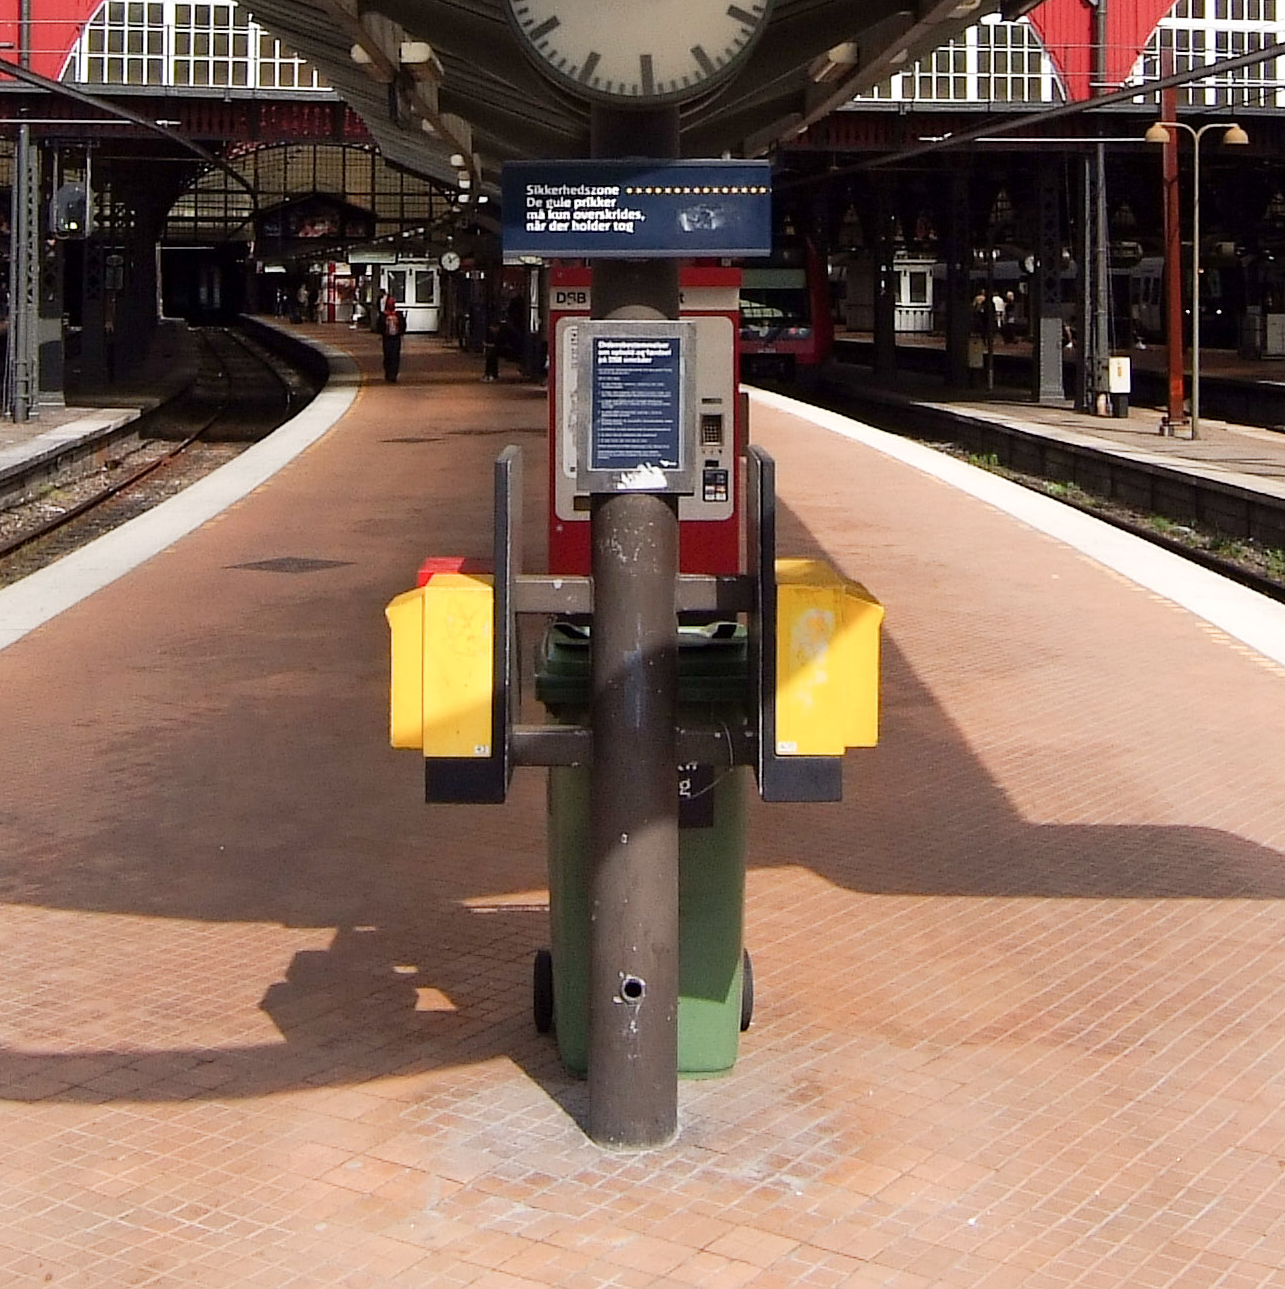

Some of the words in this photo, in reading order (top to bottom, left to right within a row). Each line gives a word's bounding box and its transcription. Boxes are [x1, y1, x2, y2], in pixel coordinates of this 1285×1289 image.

[526, 185, 620, 195] Sikkerhedszone
[526, 197, 543, 208] De
[546, 197, 571, 210] gule
[574, 196, 617, 210] prikker
[526, 209, 546, 220] må
[548, 210, 571, 220] kun
[573, 208, 646, 222] overskrides,
[526, 220, 547, 232] når
[548, 221, 570, 232] der
[572, 220, 612, 232] holder
[613, 221, 634, 233] tog
